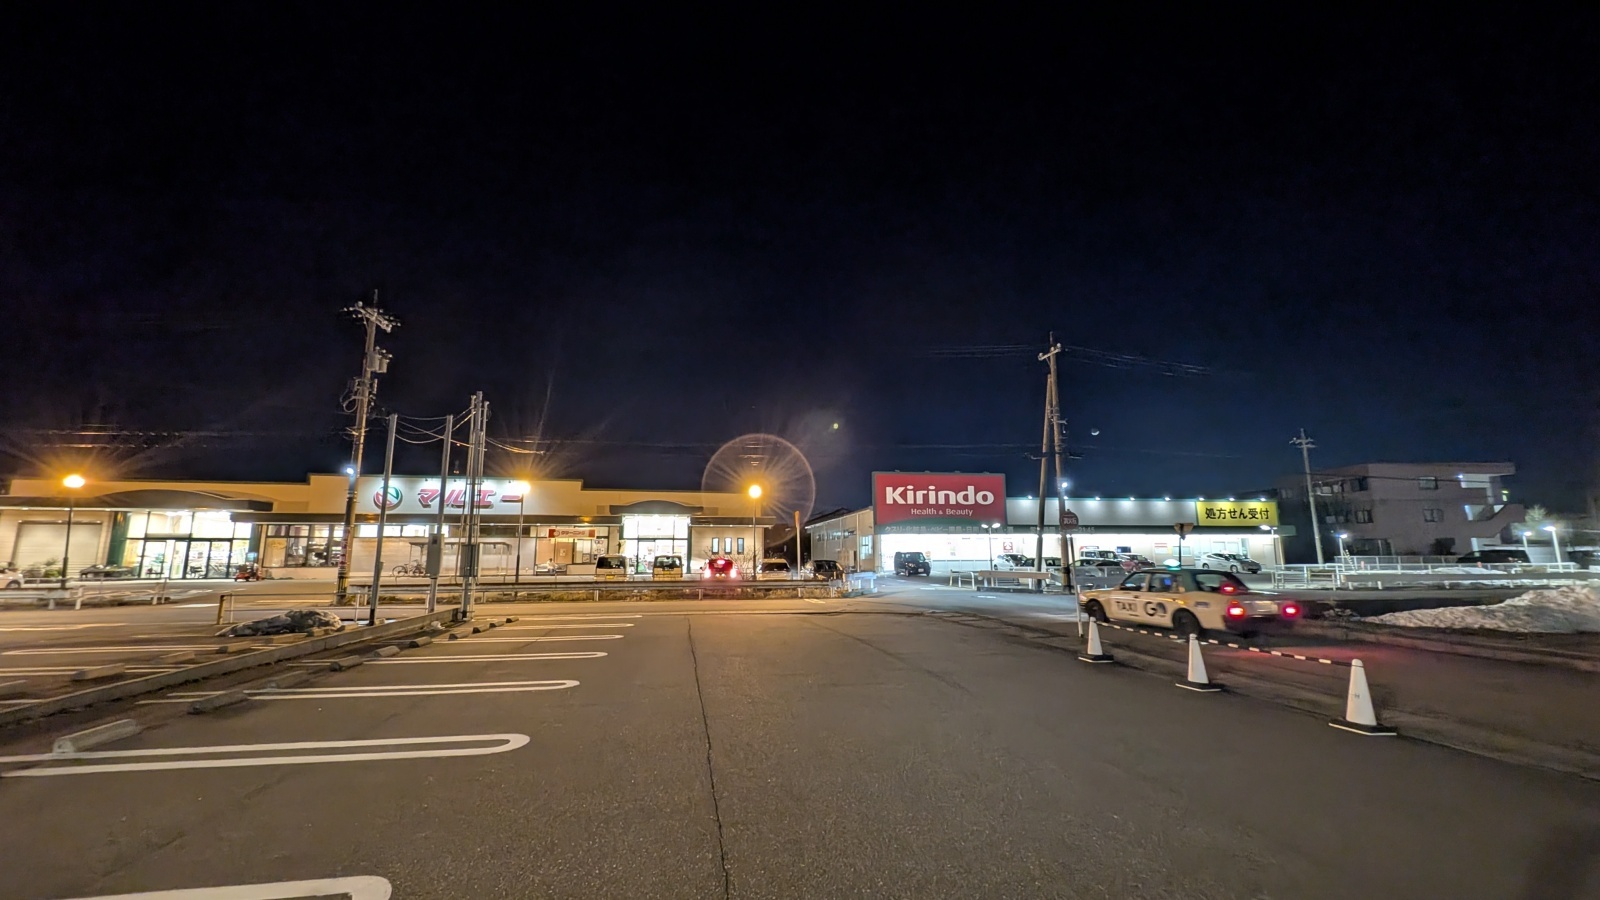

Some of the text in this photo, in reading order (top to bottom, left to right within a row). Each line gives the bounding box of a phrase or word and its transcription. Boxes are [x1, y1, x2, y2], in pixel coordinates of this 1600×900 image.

[418, 488, 522, 508] マルエー
[885, 485, 995, 505] Kirindo
[945, 508, 974, 516] Beauty
[1205, 507, 1270, 520] 処方せん受付
[1115, 600, 1138, 613] TAXI
